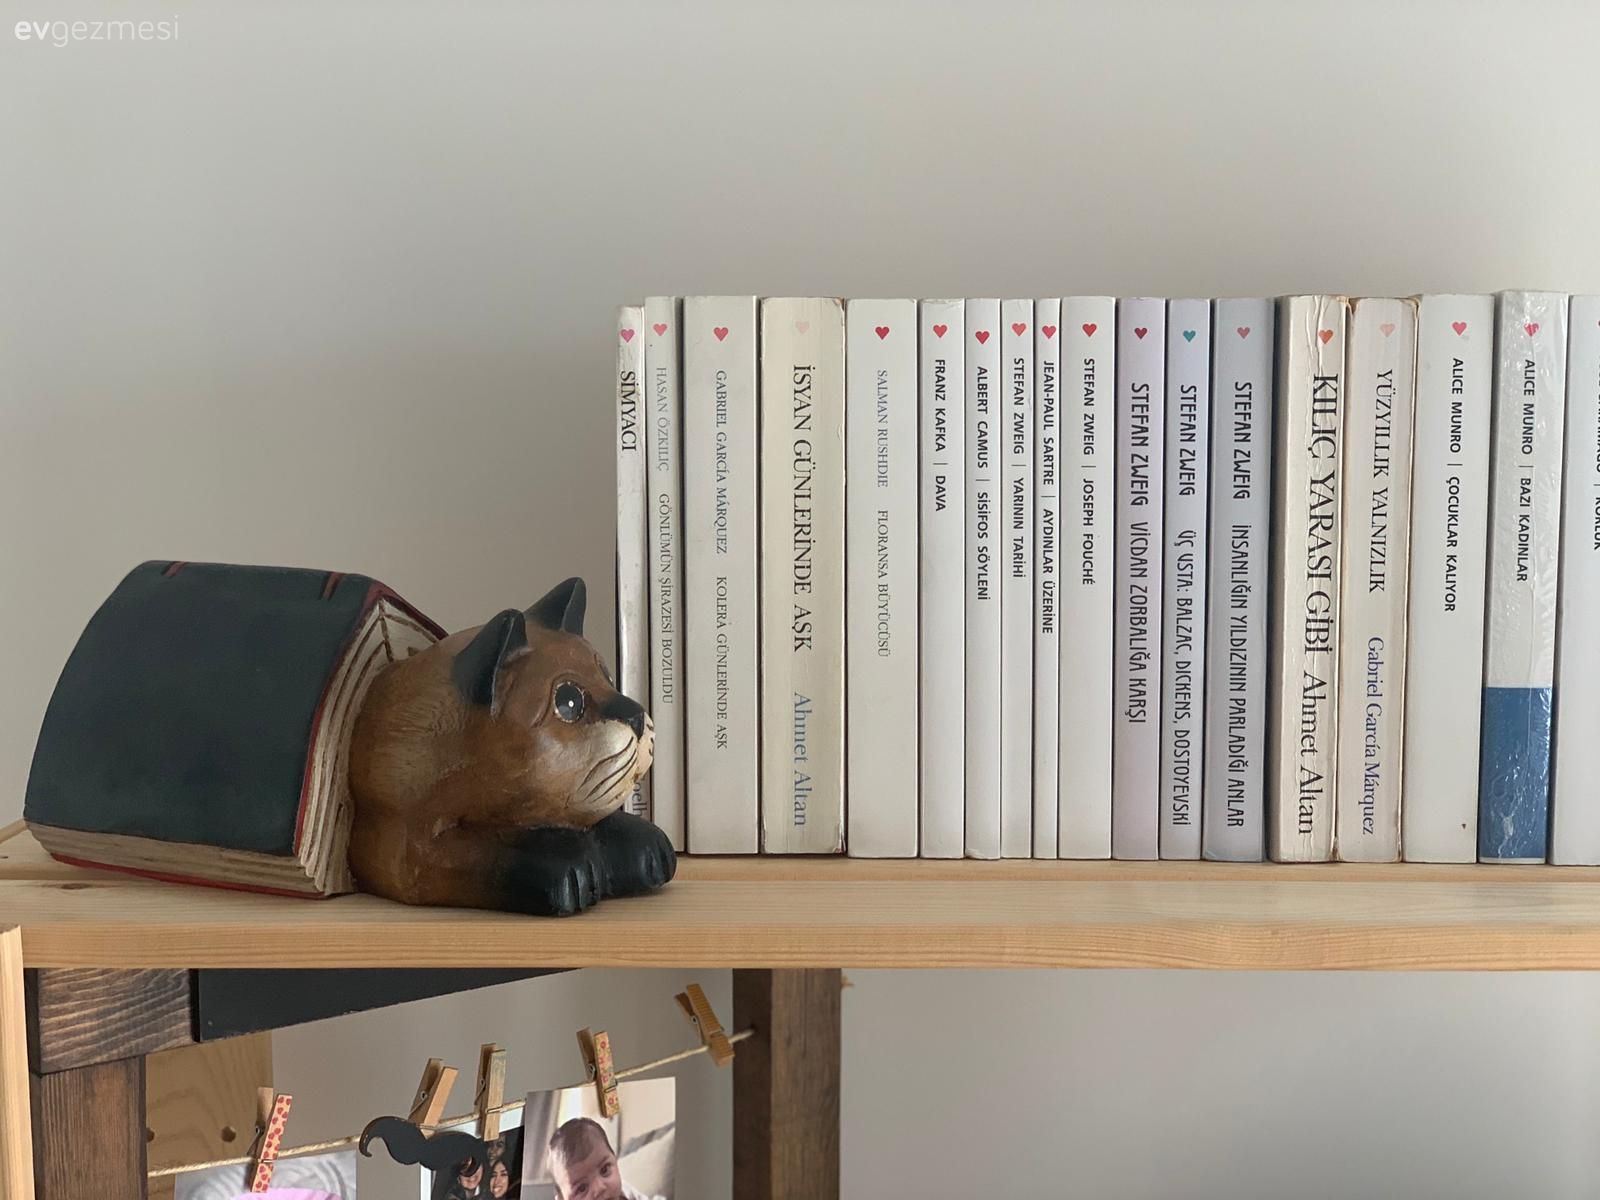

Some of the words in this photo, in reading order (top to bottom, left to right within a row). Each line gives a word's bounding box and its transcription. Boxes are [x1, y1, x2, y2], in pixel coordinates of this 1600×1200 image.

[656, 367, 668, 413] HASAN
[715, 370, 728, 428] GABRIEL
[793, 364, 816, 431] İSYAN
[877, 369, 889, 424] SALMAN
[934, 359, 946, 401] FRANZ
[976, 366, 988, 415] ALBERT
[1013, 357, 1025, 406] STEFAN
[1043, 360, 1055, 431] JEAN-PAUL
[1083, 358, 1095, 407] STEFAN
[1451, 357, 1464, 395] ALICE
[1523, 359, 1536, 396] ALICE
[619, 370, 640, 451] SİMYACI
[935, 407, 946, 452] KAFKA
[1013, 412, 1025, 455] ZWEIG
[1083, 413, 1095, 456] ZWEIG
[1130, 382, 1150, 447] STEFAN
[1179, 384, 1197, 443] STEFAN
[1233, 381, 1253, 443] STEFAN
[1306, 370, 1339, 461] KILIÇ
[1373, 368, 1396, 479] YÜZYILLIK
[1449, 401, 1463, 454] MUNRO
[1521, 403, 1535, 455] MUNRO
[656, 416, 671, 472] ÖZKILIÇ
[716, 431, 730, 483] GARCÍA
[877, 428, 889, 488] RUSHDIE
[977, 420, 989, 469] CAMUS
[1042, 437, 1055, 486] SARTRE
[1178, 448, 1196, 496] ZWEIG
[935, 475, 946, 512] DAVA
[1082, 478, 1094, 527] JOSEPH
[1130, 453, 1149, 506] ZWEIG
[1232, 448, 1251, 500] ZWEIG
[1519, 477, 1532, 508] BAZI
[713, 487, 730, 554] MÁRQUEZ
[793, 439, 817, 595] GÜNLERİNDE
[977, 491, 992, 539] SİSİFOS
[1013, 477, 1025, 530] YARININ
[1306, 469, 1339, 582] YARASI
[1445, 476, 1460, 548] ÇOCUKLAR
[658, 493, 674, 573] GÖNLÜMÜN
[877, 510, 889, 579] FLORANSA
[1012, 535, 1027, 578] TARİHİ
[1042, 508, 1054, 574] AYDINLAR
[1082, 533, 1096, 585] FOUCHÉ
[1129, 521, 1152, 578] VİCDAN
[1173, 529, 1197, 548] ÜÇ
[1369, 487, 1389, 593] YALNIZLIK
[1516, 514, 1531, 582] KADINLAR
[977, 545, 991, 600] SÖYLENİ
[1176, 553, 1194, 592] USTA:
[1230, 524, 1252, 609] İNSANLIĞIN
[1444, 554, 1457, 612] KALIYOR
[658, 577, 675, 634] ŞİRAZESİ
[716, 576, 729, 630] KOLERA
[791, 604, 813, 653] AŞK
[877, 583, 891, 657] BÜYÜCÜSÜ
[1042, 579, 1057, 634] ÜZERİNE
[1128, 584, 1151, 672] ZORBALIĞA
[1173, 597, 1193, 655] BALZAC,
[1304, 590, 1338, 655] GİBİ
[660, 637, 675, 704] BOZULDU
[716, 633, 730, 720] GÜNLERİNDE
[1229, 615, 1248, 692] YILDIZININ
[1366, 636, 1385, 698] Gabriel
[1124, 678, 1147, 723] KARŞI
[1172, 660, 1192, 724] DICKENS,
[1300, 669, 1328, 758] Ahmet
[714, 724, 728, 749] AŞK
[793, 691, 813, 763] Ahmet
[1227, 697, 1249, 773] PARLADIĞI
[1364, 702, 1383, 758] García
[793, 769, 813, 827] Altan
[1172, 729, 1192, 826] DOSTOYEVSKİ
[1227, 778, 1245, 827] ANLAR
[1298, 764, 1324, 835] Altan
[1357, 762, 1381, 835] Márquez
